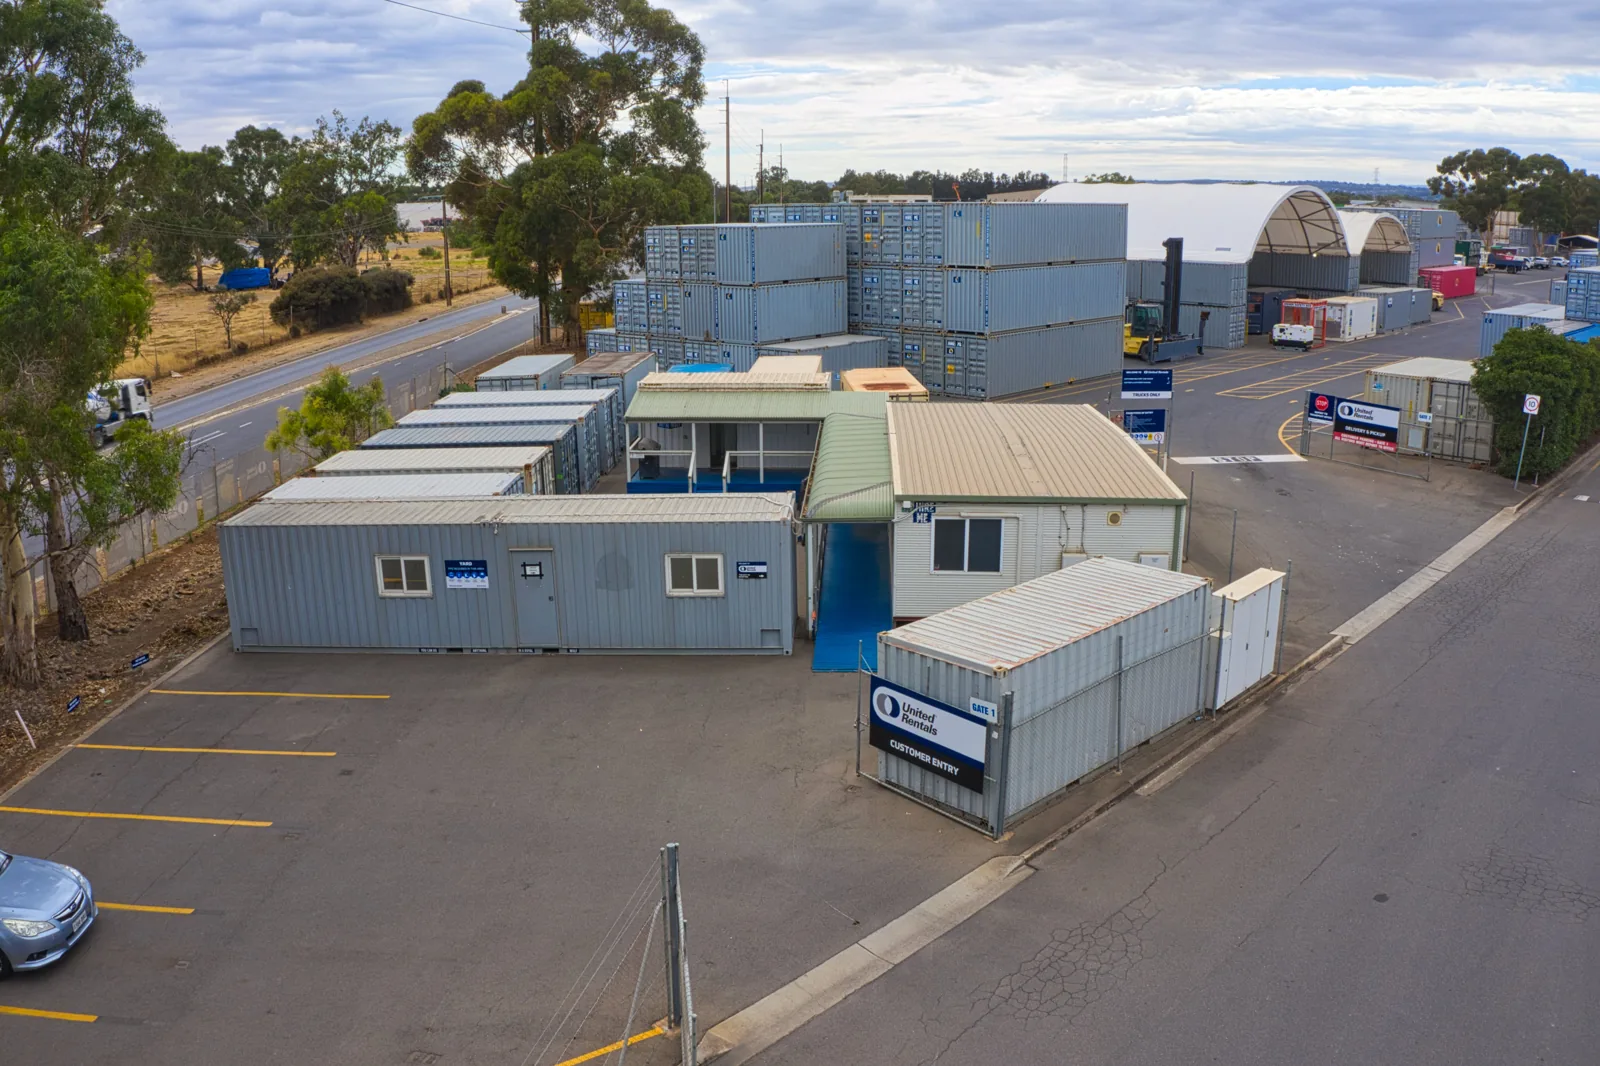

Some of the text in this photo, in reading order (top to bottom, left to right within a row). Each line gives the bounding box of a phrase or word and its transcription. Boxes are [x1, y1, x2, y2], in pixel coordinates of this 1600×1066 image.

[1354, 406, 1373, 414] United
[1354, 412, 1374, 420] Rentals
[1345, 426, 1366, 434] DELIVERY
[916, 513, 929, 523] ME
[902, 702, 935, 724] United
[972, 702, 995, 717] GATE 1
[901, 714, 938, 736] Rentals
[890, 739, 960, 776] CUSTOMER ENTRY
